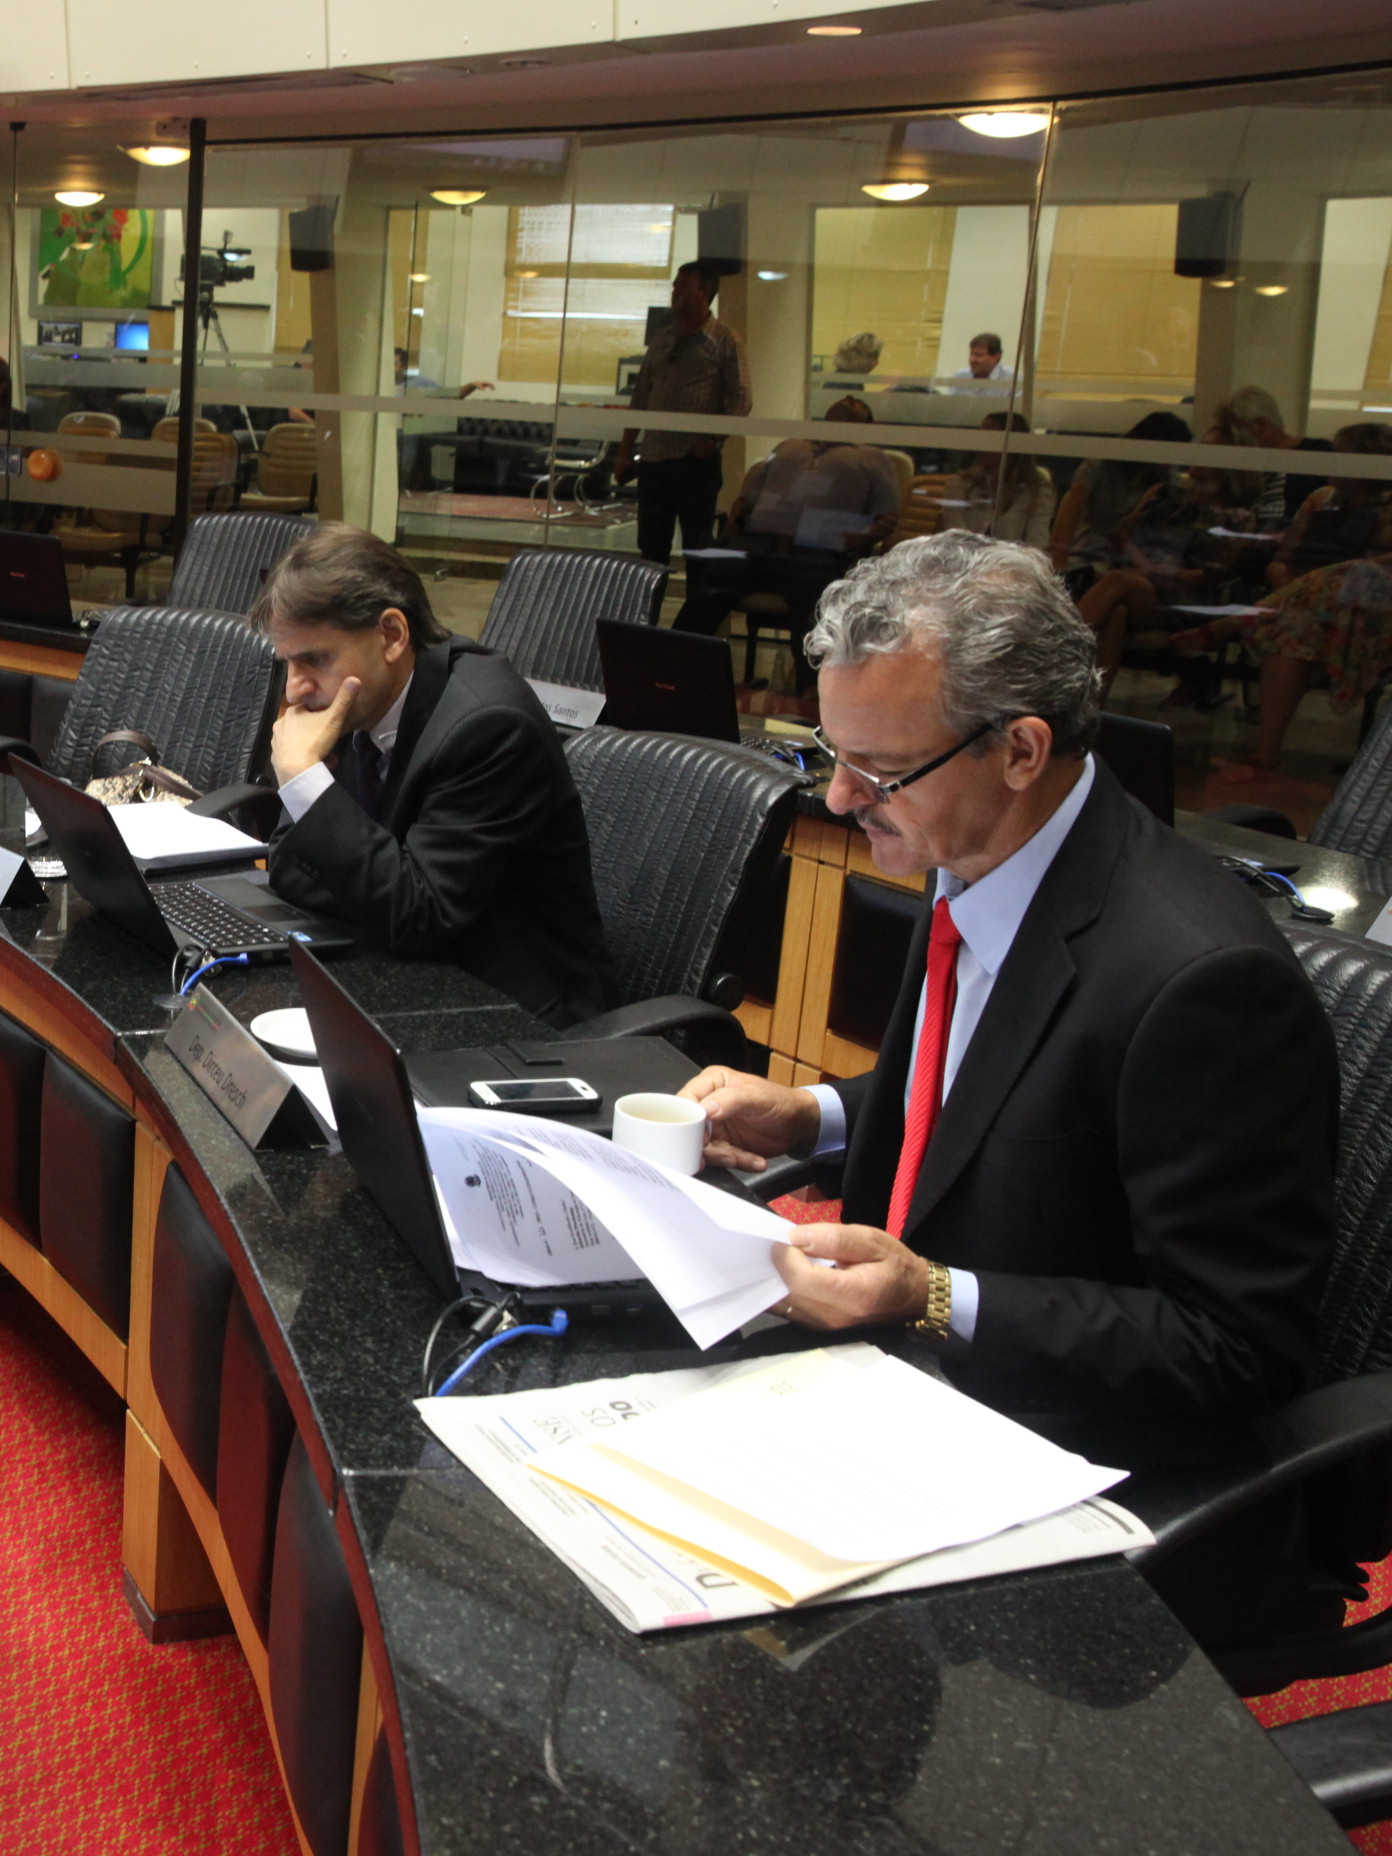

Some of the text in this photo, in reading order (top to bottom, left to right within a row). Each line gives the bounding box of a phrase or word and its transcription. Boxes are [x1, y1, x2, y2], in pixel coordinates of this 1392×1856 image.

[553, 703, 579, 719] Santos
[188, 1034, 205, 1063] Dep.
[202, 1050, 225, 1085] Dirceu
[221, 1072, 248, 1110] Dresch
